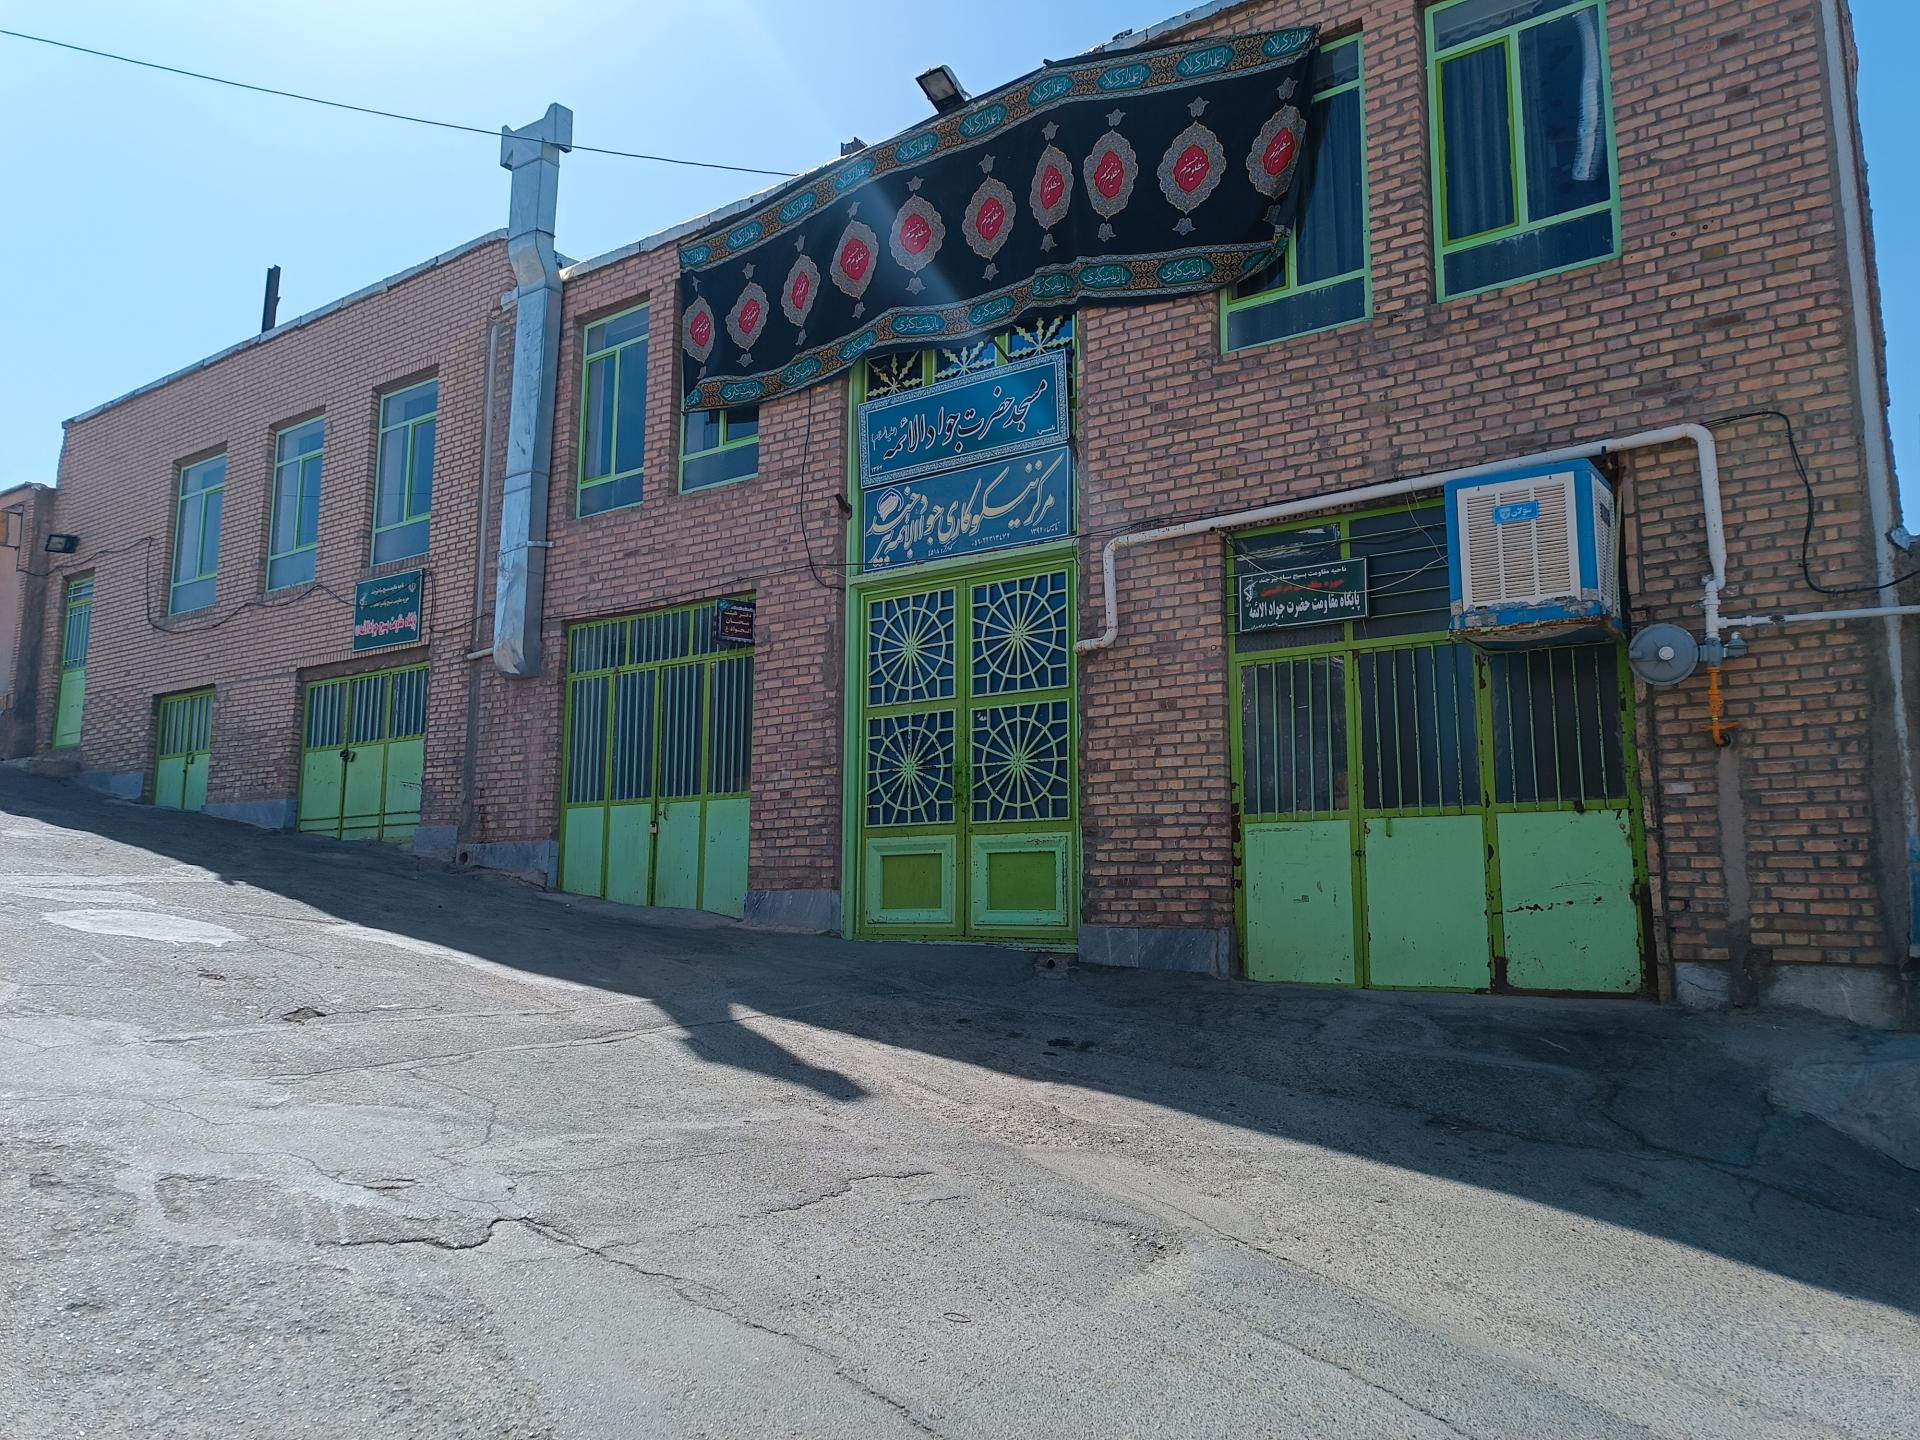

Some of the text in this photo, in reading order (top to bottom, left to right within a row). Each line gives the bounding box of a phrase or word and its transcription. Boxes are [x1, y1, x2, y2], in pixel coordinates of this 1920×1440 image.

[956, 386, 1016, 441] حضرت
[1003, 379, 1048, 433] مسجد
[925, 407, 963, 453] جواد
[1023, 453, 1065, 527] مرکز
[1308, 568, 1330, 578] مقاومت
[1331, 565, 1347, 574] ناحیه
[1268, 600, 1286, 619] جواد
[1287, 597, 1311, 617] حضرت
[1312, 593, 1339, 614] مقاومت
[1340, 590, 1360, 611] پایگاه
